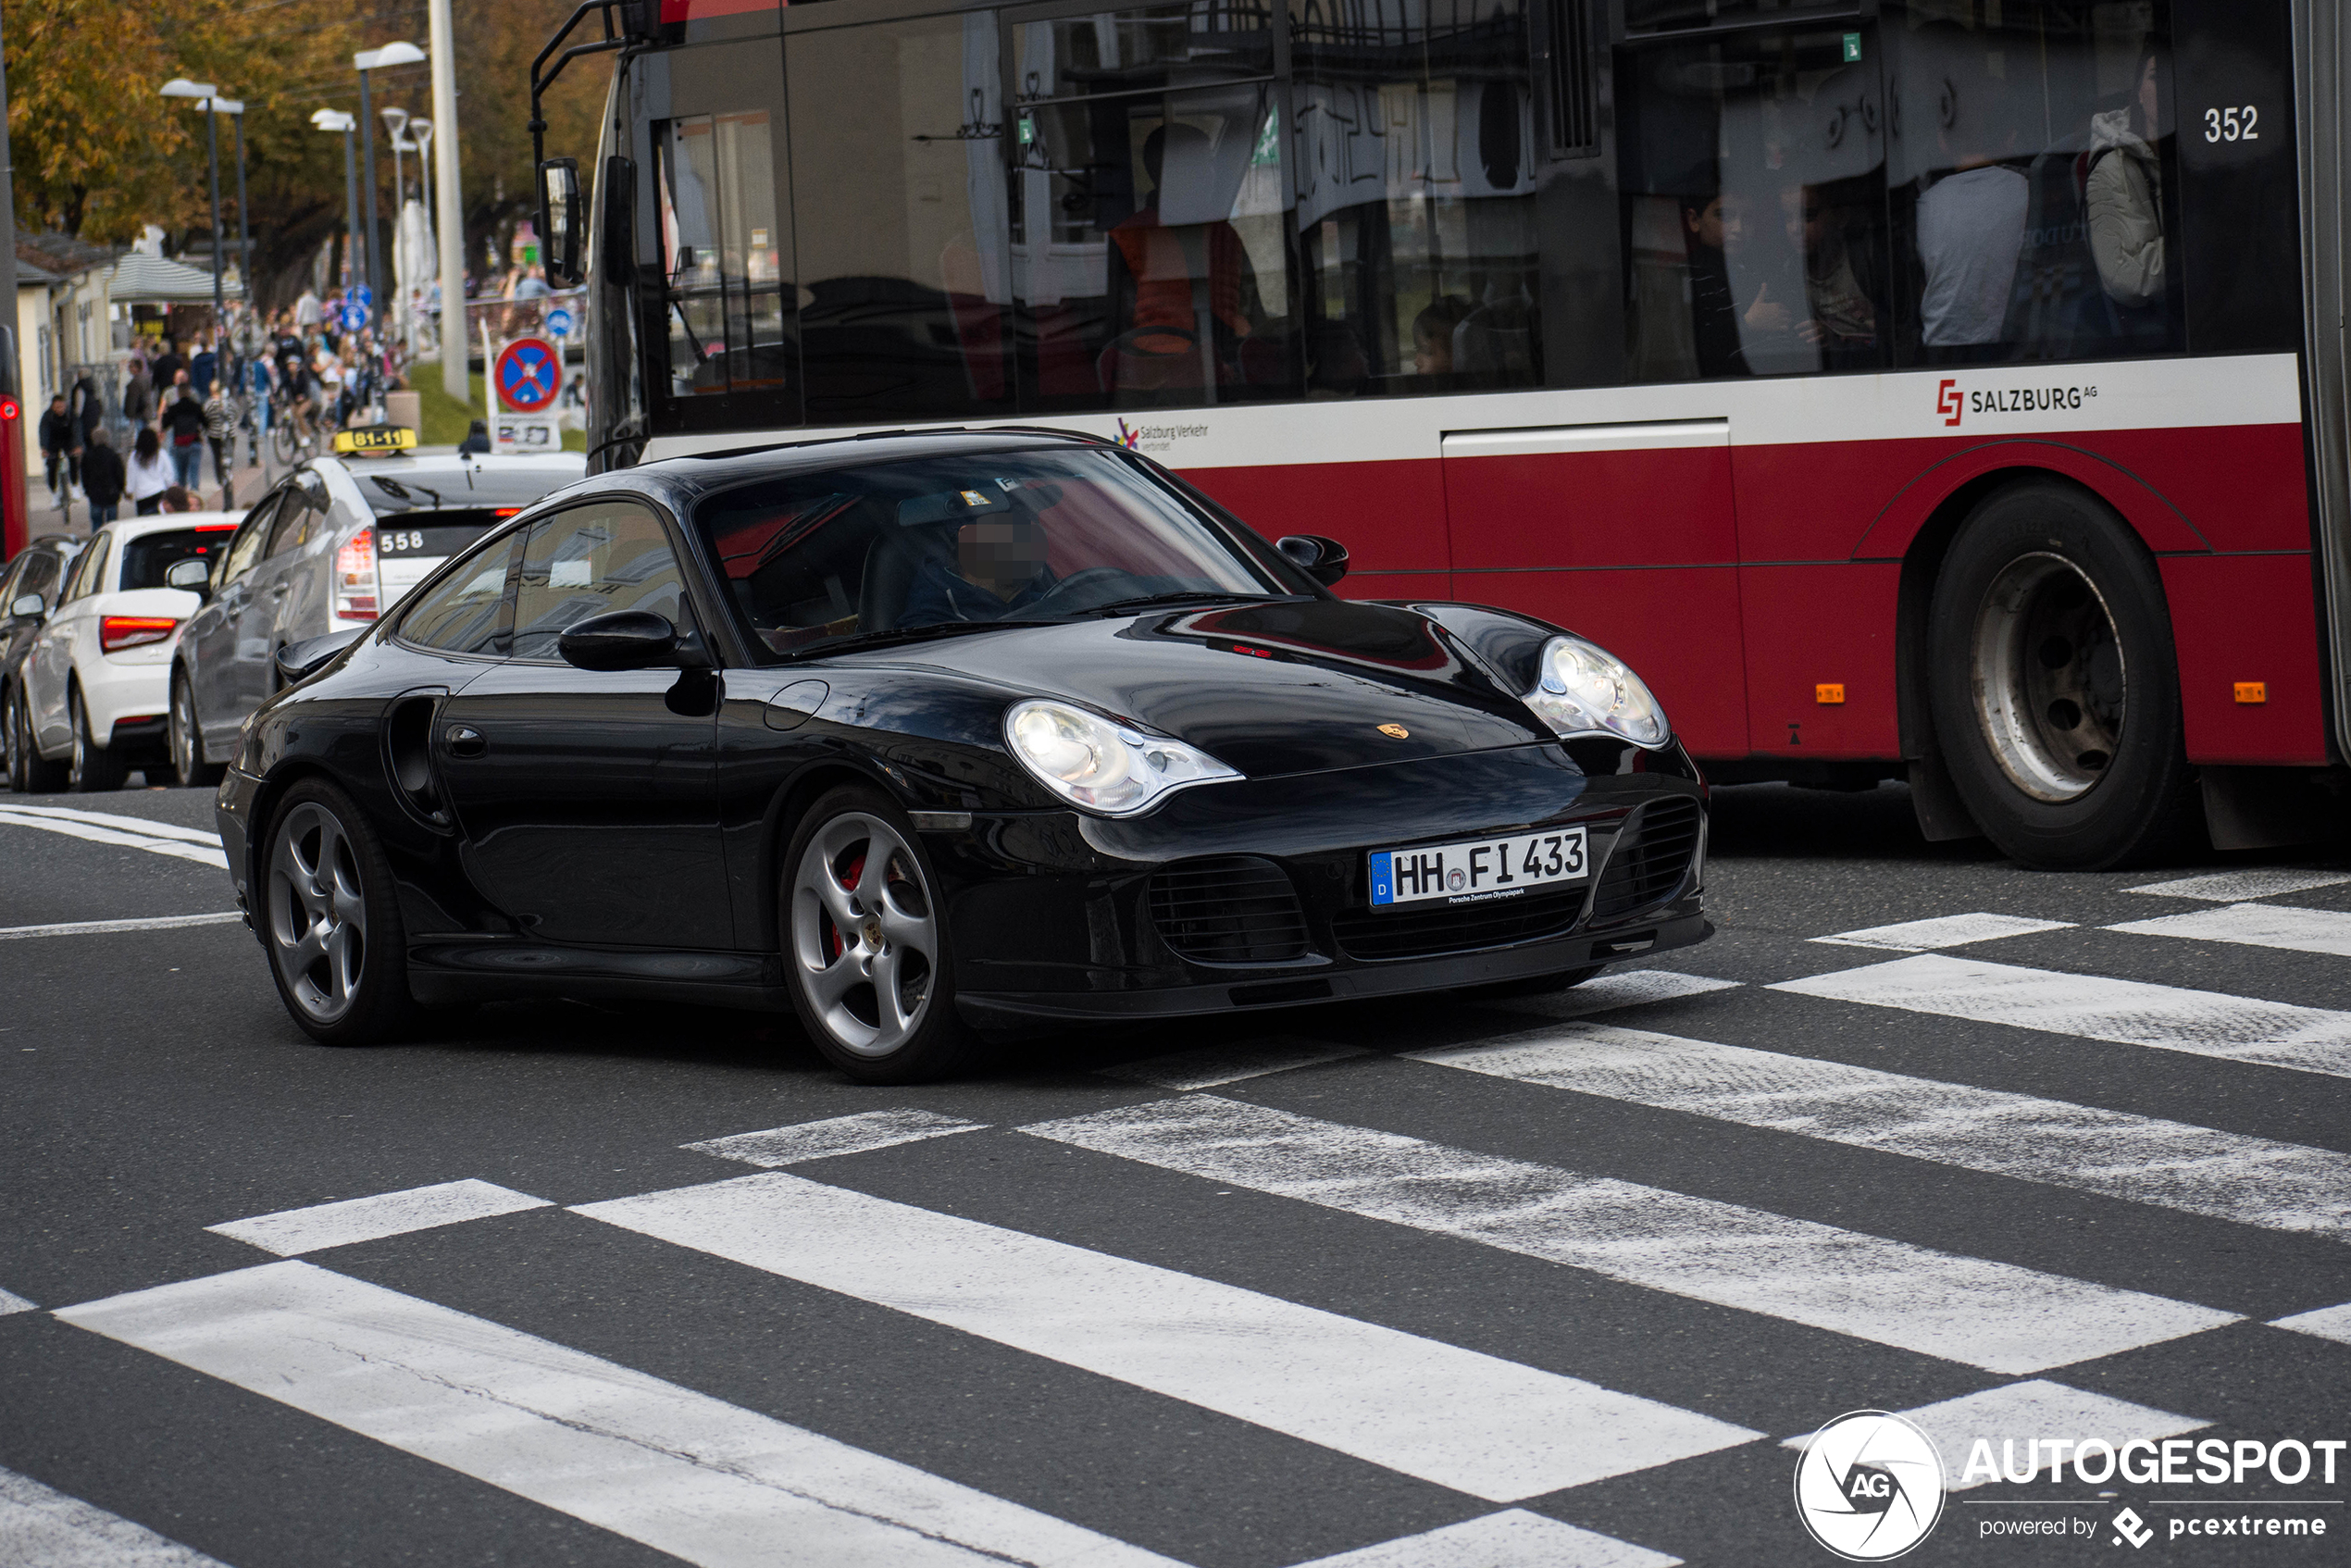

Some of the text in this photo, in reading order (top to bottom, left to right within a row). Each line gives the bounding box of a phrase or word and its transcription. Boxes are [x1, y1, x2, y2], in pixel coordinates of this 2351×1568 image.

[2205, 105, 2258, 143] 352
[1972, 386, 2097, 413] SALZBURG AG
[355, 429, 403, 446] 81-11
[1140, 424, 1209, 440] Salzburg Verkehr
[380, 530, 424, 553] 558
[1395, 832, 1584, 896] HH FI 433
[1378, 884, 1387, 896] D
[1449, 888, 1524, 904] Porsche Zentrum Olympiapark
